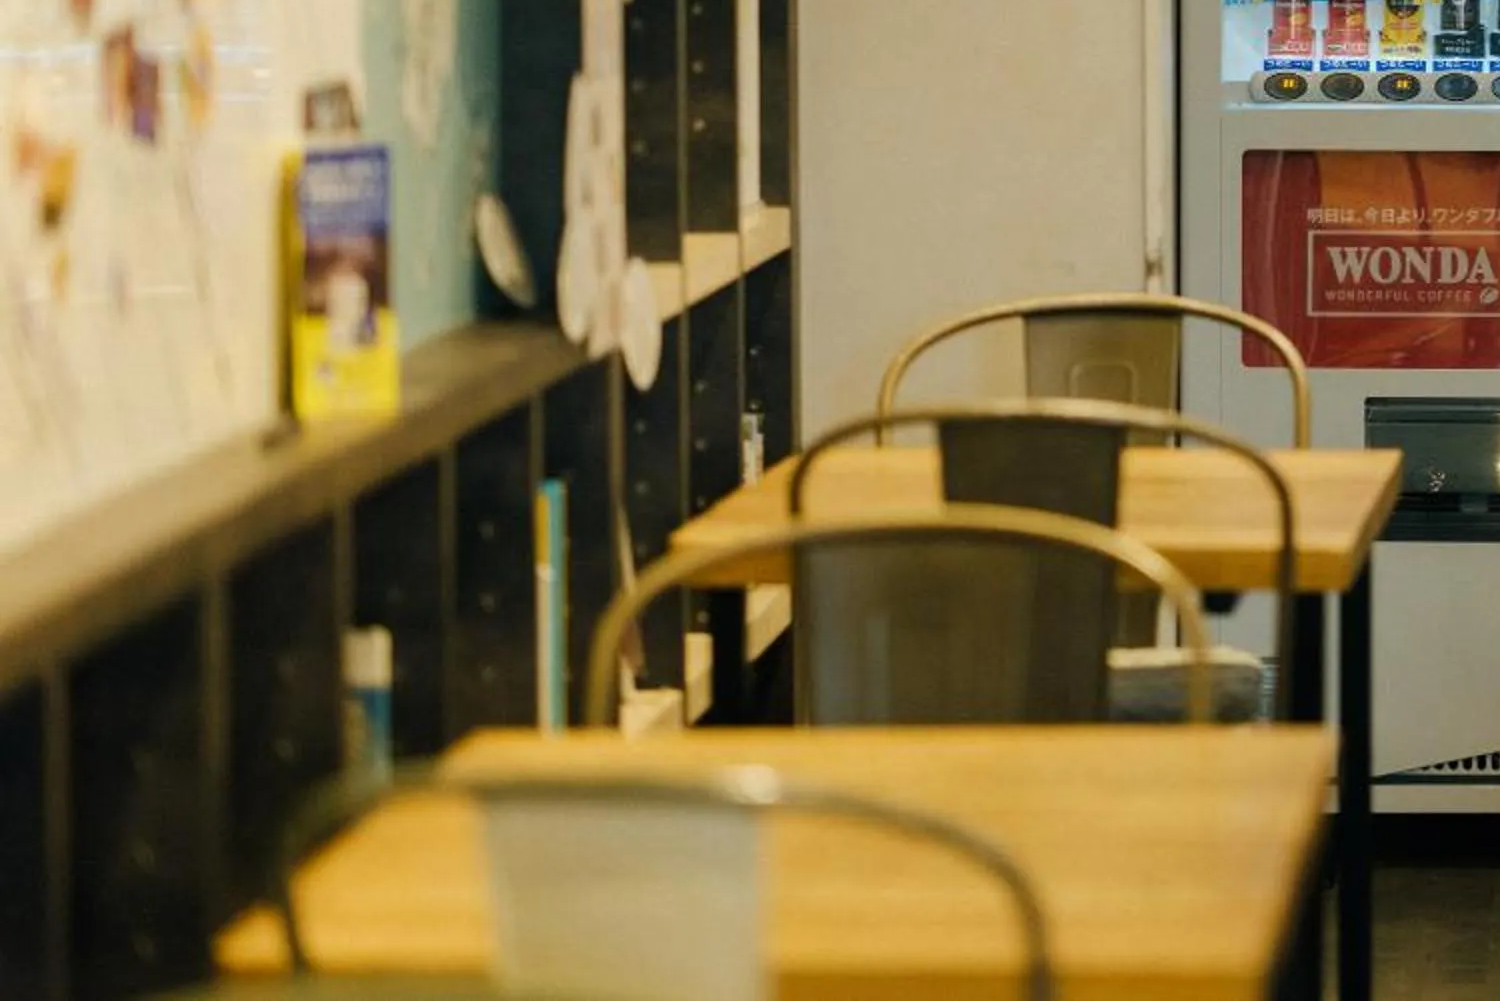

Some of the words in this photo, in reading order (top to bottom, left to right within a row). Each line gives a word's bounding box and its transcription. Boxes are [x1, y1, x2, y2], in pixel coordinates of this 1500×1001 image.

[1327, 247, 1498, 284] WONDA
[1325, 290, 1409, 303] WONDERFUL
[1417, 290, 1473, 303] COFFEE
